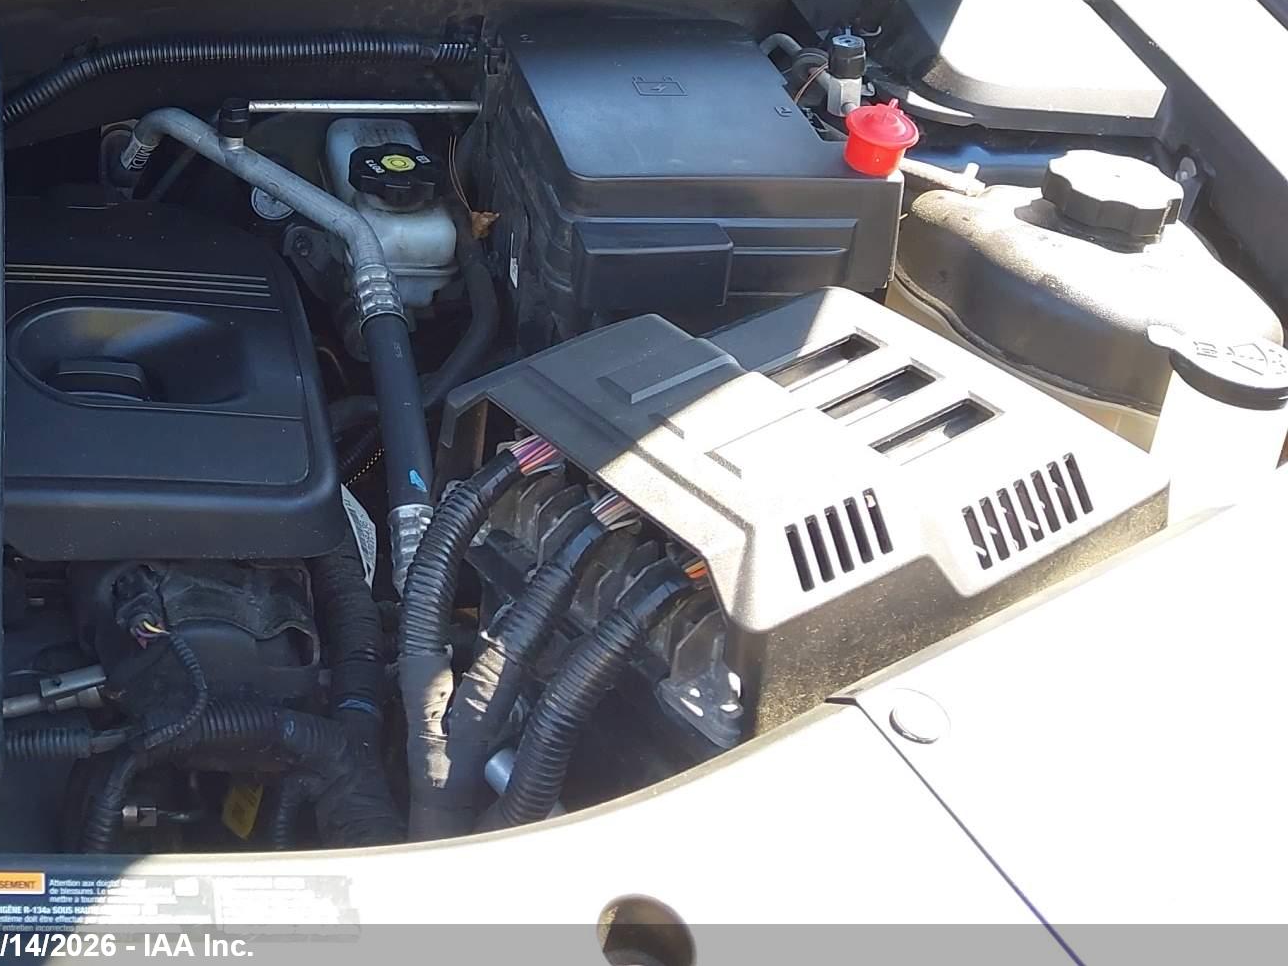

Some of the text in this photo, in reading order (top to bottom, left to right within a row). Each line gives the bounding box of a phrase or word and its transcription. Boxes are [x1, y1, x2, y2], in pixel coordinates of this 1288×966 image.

[49, 879, 81, 887] Attention
[49, 895, 73, 903] mettre
[23, 905, 51, 914] R-134a
[52, 906, 73, 914] SOUS
[24, 915, 38, 923] doit
[38, 915, 54, 923] être
